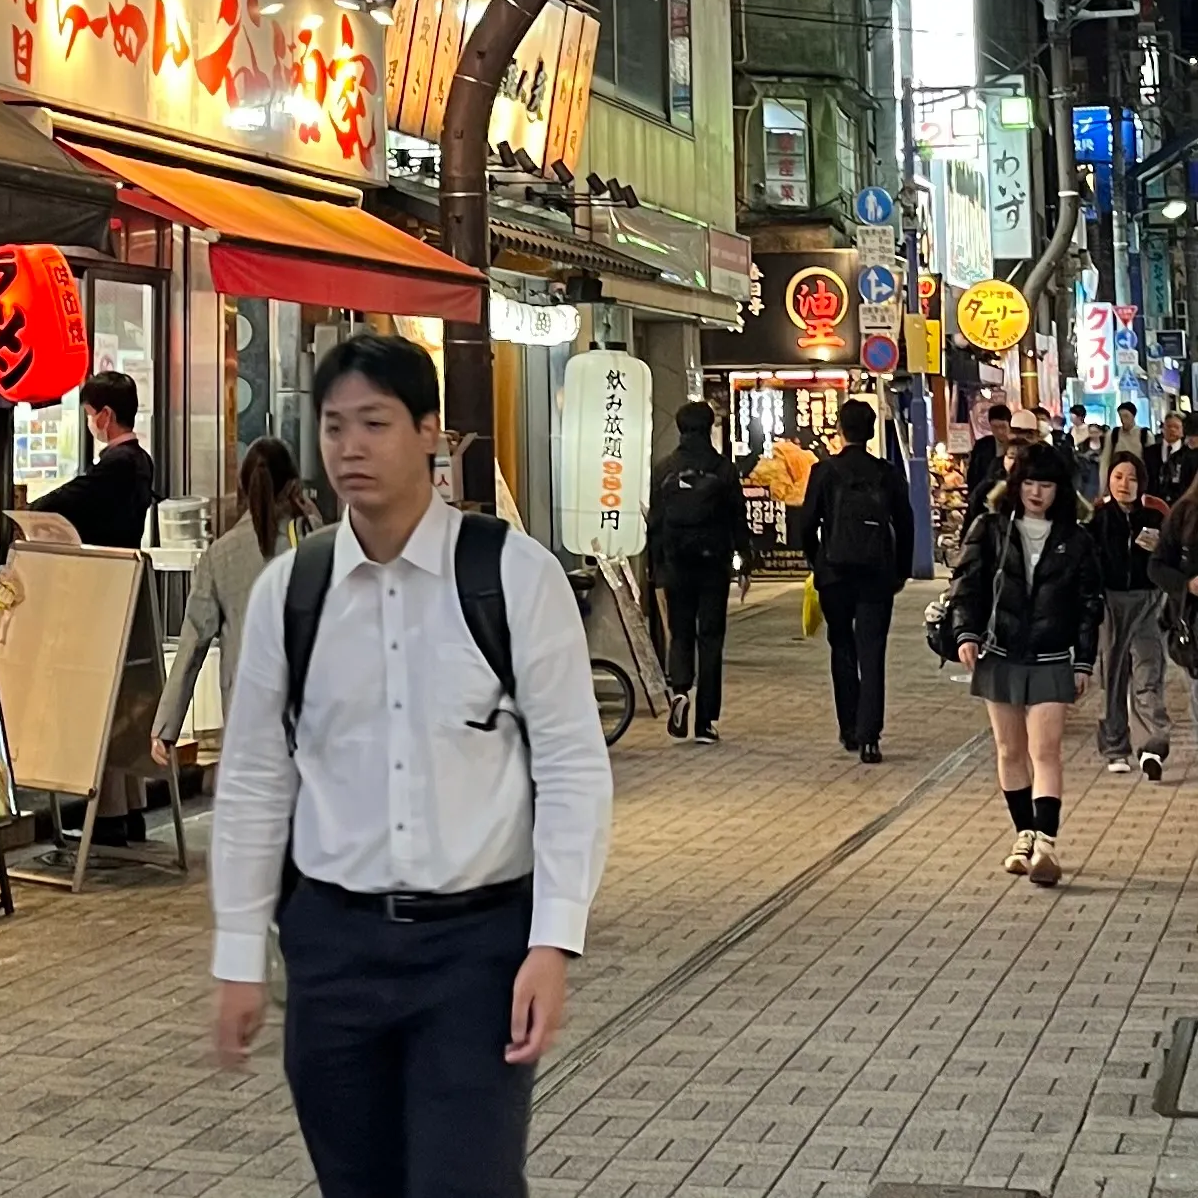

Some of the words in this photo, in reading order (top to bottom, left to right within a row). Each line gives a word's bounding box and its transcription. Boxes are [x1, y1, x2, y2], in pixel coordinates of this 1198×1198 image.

[993, 149, 1025, 231] わいず
[1087, 307, 1111, 390] クスリ
